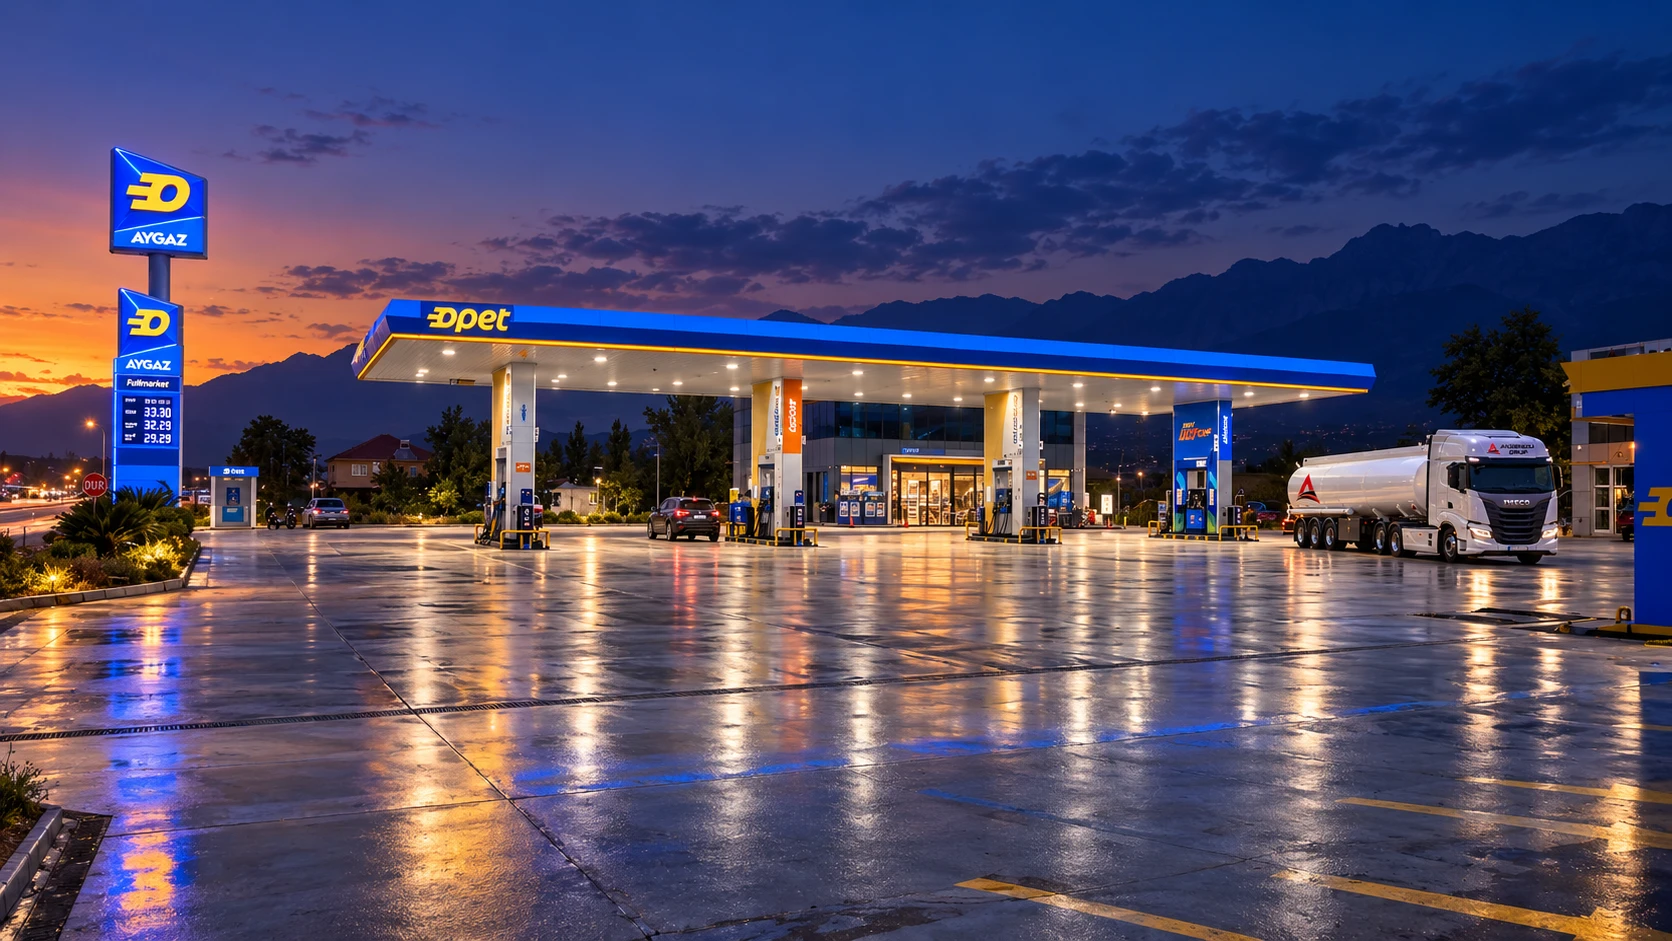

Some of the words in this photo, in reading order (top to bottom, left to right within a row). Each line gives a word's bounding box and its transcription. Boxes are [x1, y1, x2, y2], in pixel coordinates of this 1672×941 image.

[130, 231, 188, 246] AYGAZ
[427, 306, 511, 333] Opet
[125, 359, 171, 371] AYGAZ
[144, 407, 172, 418] 33.30
[144, 420, 172, 431] 32.29
[144, 433, 172, 444] 29.29
